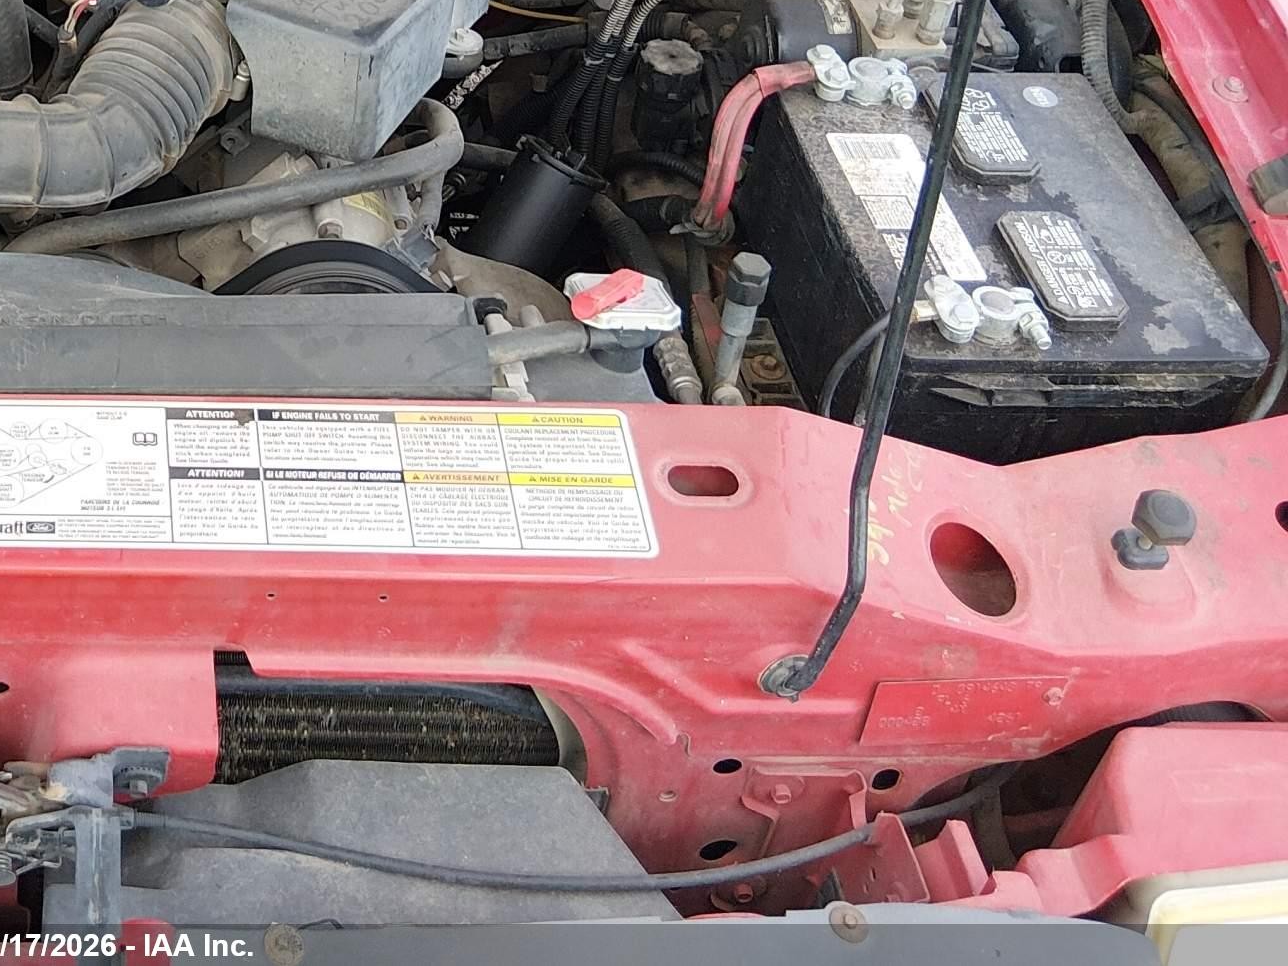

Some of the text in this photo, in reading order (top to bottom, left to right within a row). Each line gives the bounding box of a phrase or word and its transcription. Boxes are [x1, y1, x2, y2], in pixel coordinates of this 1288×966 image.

[186, 410, 236, 418] ATTENTIO
[272, 411, 380, 421] IF ENGINE FAILS TO START
[188, 469, 245, 478] ATTENTION!
